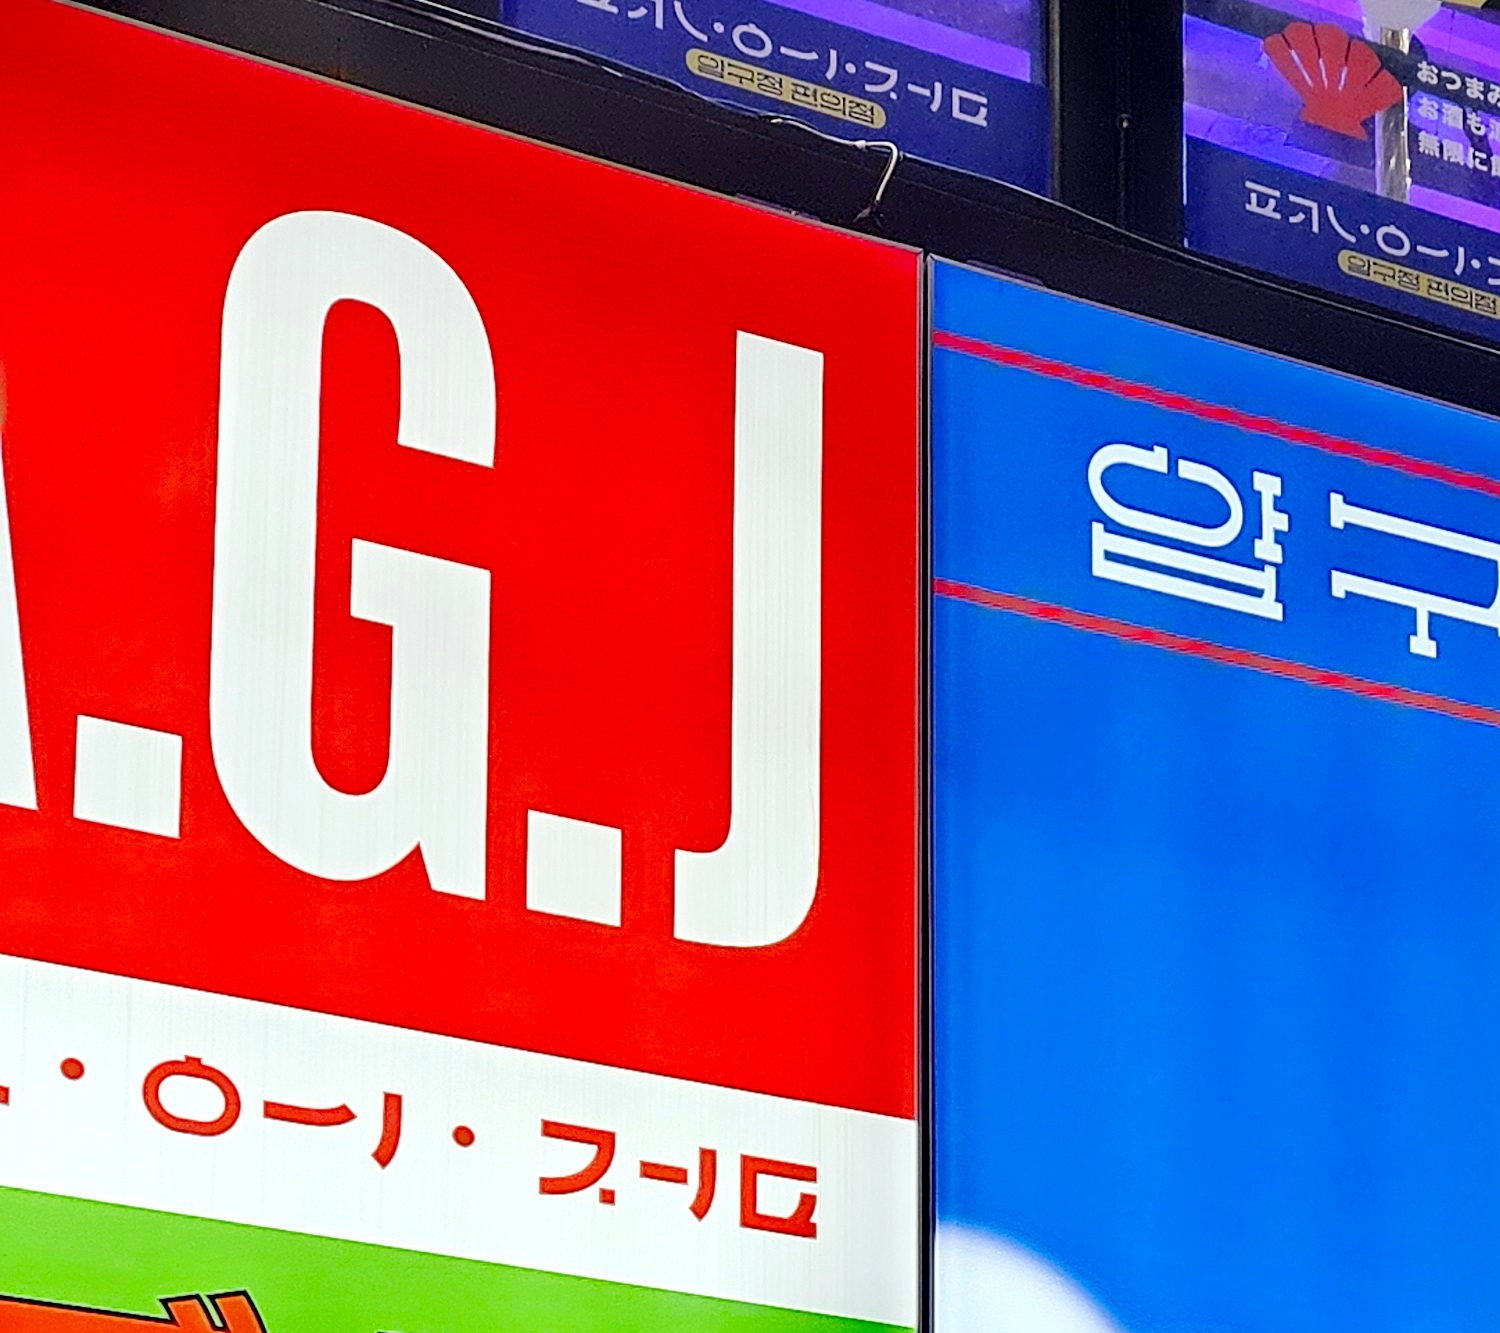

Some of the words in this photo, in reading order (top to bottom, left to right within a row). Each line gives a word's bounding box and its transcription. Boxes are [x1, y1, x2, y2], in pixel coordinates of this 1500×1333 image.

[697, 53, 783, 97] 압구정
[790, 76, 876, 125] 편의점
[1346, 253, 1421, 292] 압구정
[1425, 276, 1498, 315] 편의점
[0, 210, 824, 948] .G.J
